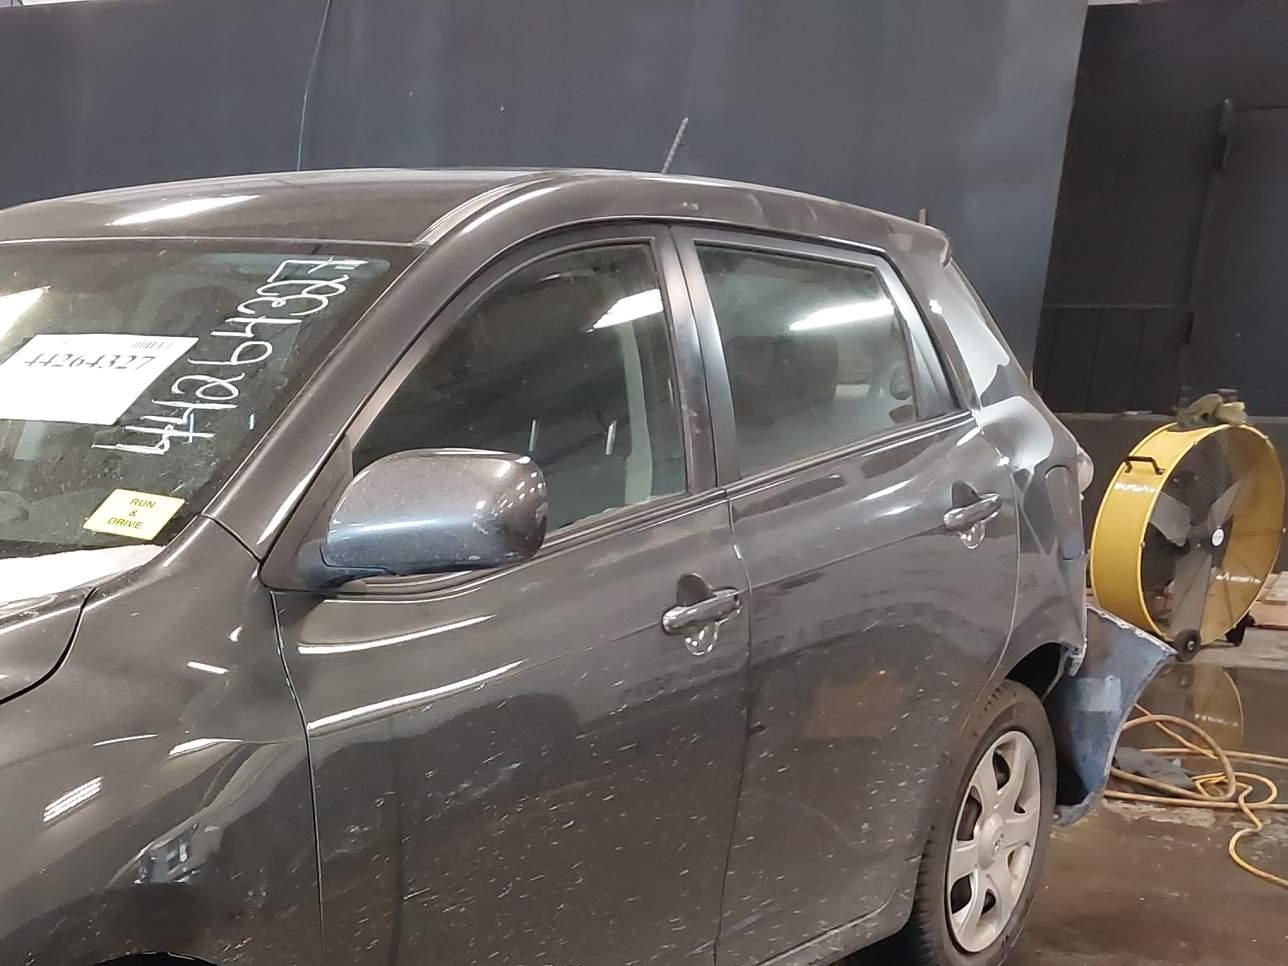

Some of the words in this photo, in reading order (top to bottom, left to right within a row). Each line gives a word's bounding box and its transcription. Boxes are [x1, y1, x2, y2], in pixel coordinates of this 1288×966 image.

[23, 352, 156, 370] 44264327
[91, 256, 369, 456] 44264327
[129, 498, 156, 509] RUN
[129, 509, 138, 517] &
[107, 517, 143, 530] DRIVE
